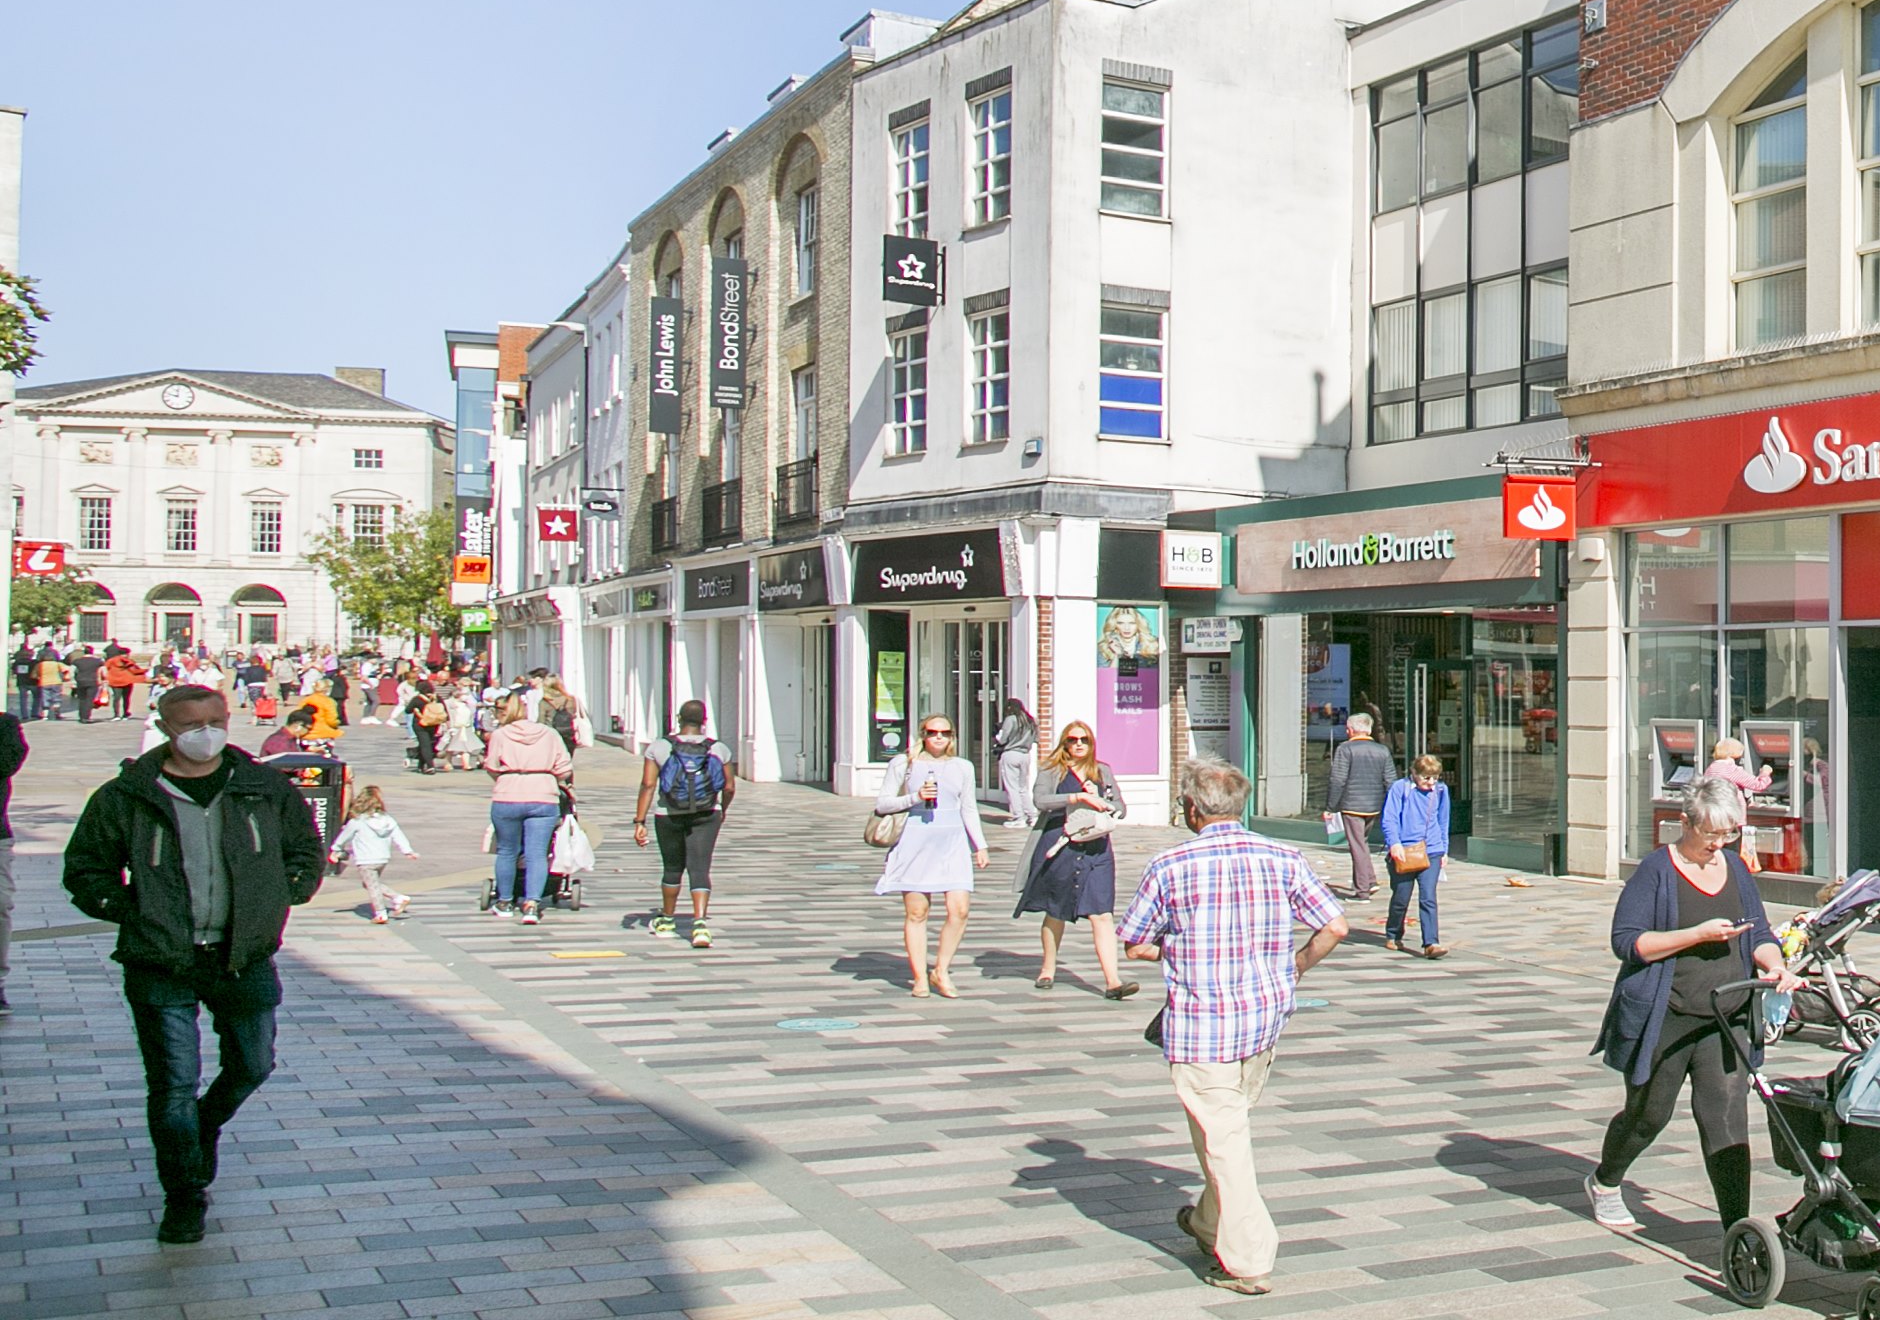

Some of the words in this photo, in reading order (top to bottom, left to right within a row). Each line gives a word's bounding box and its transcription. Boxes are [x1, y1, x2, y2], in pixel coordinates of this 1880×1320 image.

[654, 314, 676, 357] Lewis
[654, 360, 679, 397] John
[1172, 546, 1213, 563] H&B
[880, 565, 968, 592] Superdrug
[760, 580, 803, 602] Superdrug
[1114, 682, 1143, 691] BROWS
[1114, 695, 1142, 703] LASH
[1114, 707, 1142, 715] NAILS
